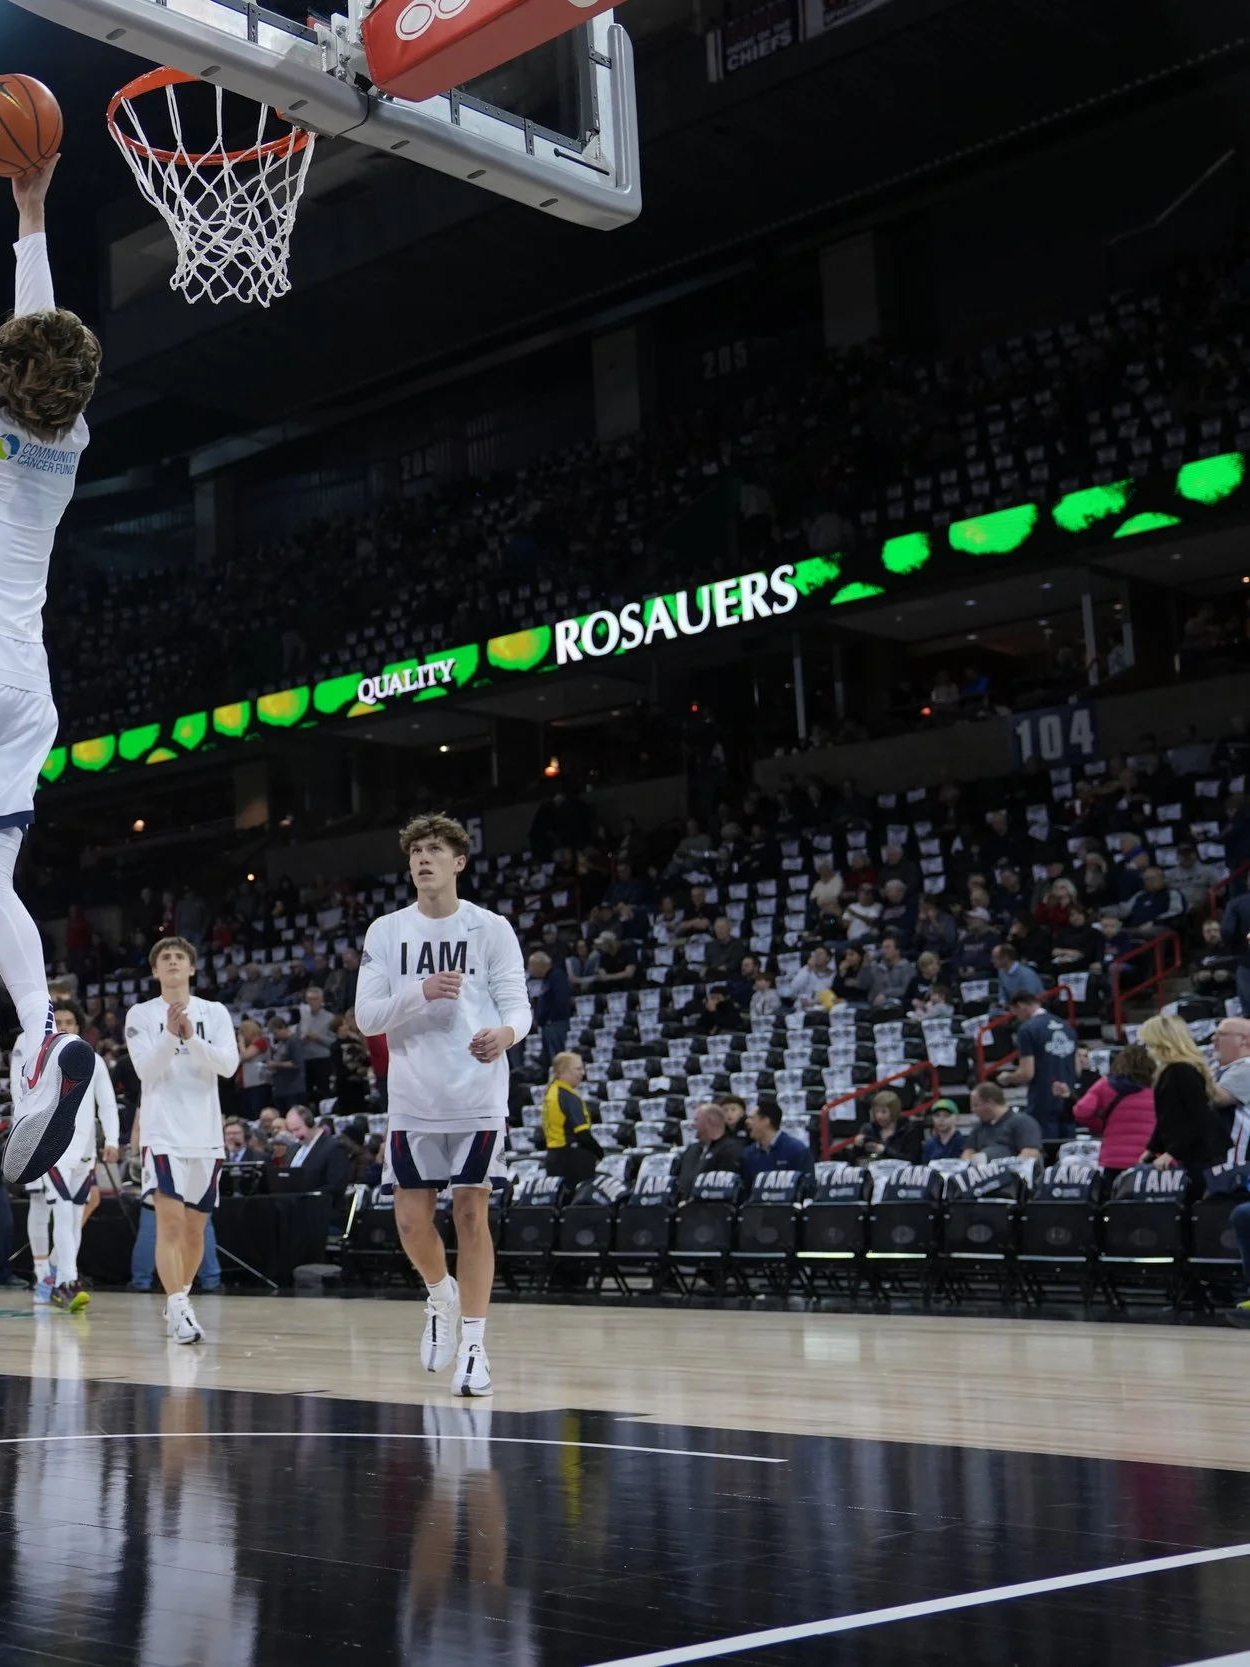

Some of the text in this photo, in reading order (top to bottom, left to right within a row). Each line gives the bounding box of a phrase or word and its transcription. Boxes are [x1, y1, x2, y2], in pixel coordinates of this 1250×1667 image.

[726, 29, 792, 71] CHIEFS
[702, 340, 748, 379] 205
[17, 455, 76, 475] CANCER FUND
[22, 443, 78, 463] COMMUNITY
[555, 564, 798, 666] ROSAUERS
[358, 658, 456, 704] QUALITY
[1015, 708, 1095, 765] 104
[400, 941, 475, 975] I AM.
[642, 1175, 671, 1194] AM.
[703, 1171, 737, 1188] AM.
[764, 1170, 796, 1189] AM.
[1145, 1170, 1184, 1193] AM.
